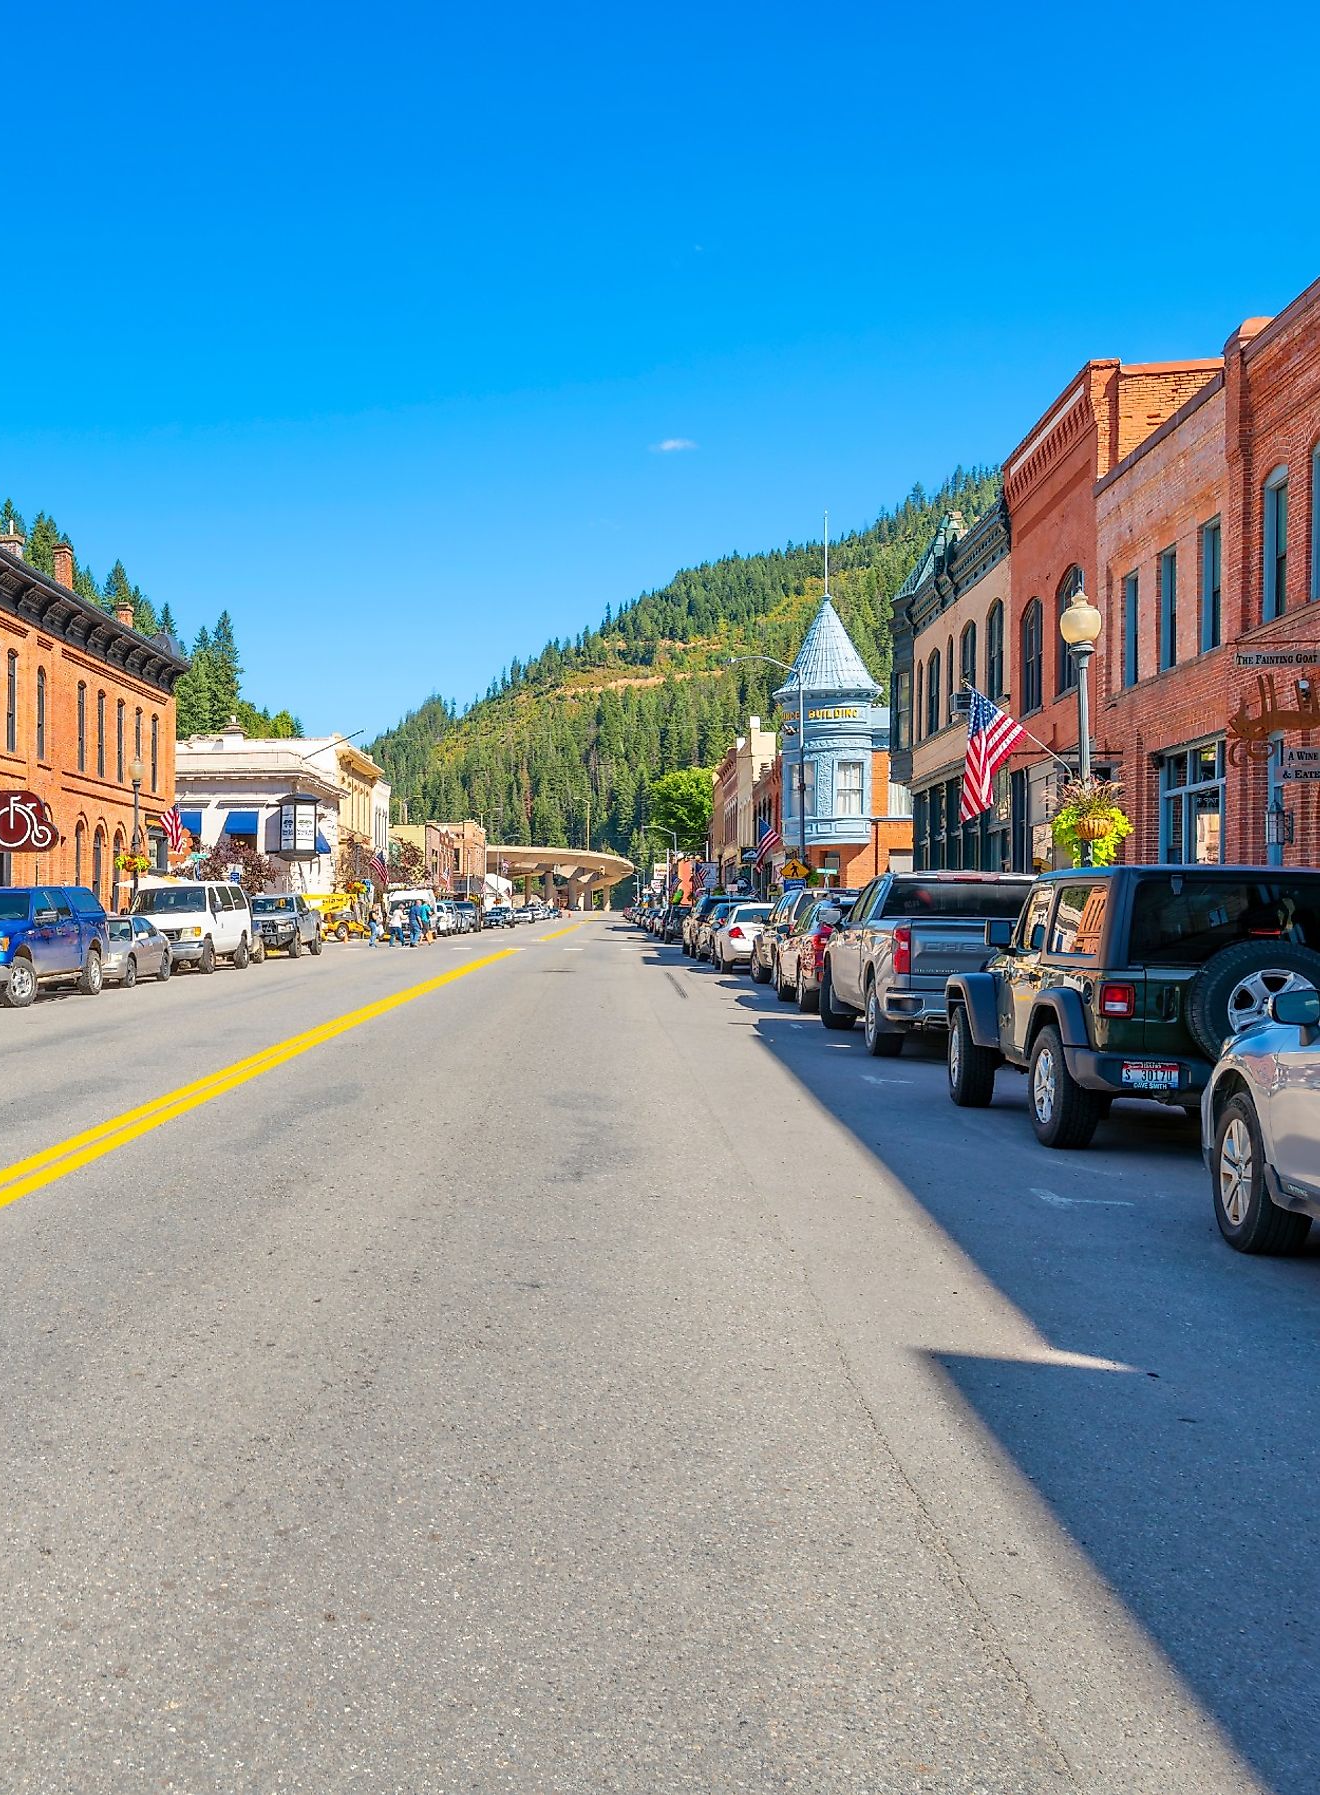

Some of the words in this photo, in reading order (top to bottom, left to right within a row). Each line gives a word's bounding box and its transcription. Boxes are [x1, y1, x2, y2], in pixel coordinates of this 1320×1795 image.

[1236, 653, 1254, 665] THE
[1255, 654, 1294, 665] FAINTING
[1295, 653, 1318, 664] GOAT
[808, 708, 858, 720] BUILDING
[1288, 751, 1295, 761] A
[1296, 751, 1319, 761] WINE
[1282, 770, 1292, 779] &
[1125, 1069, 1131, 1081] S
